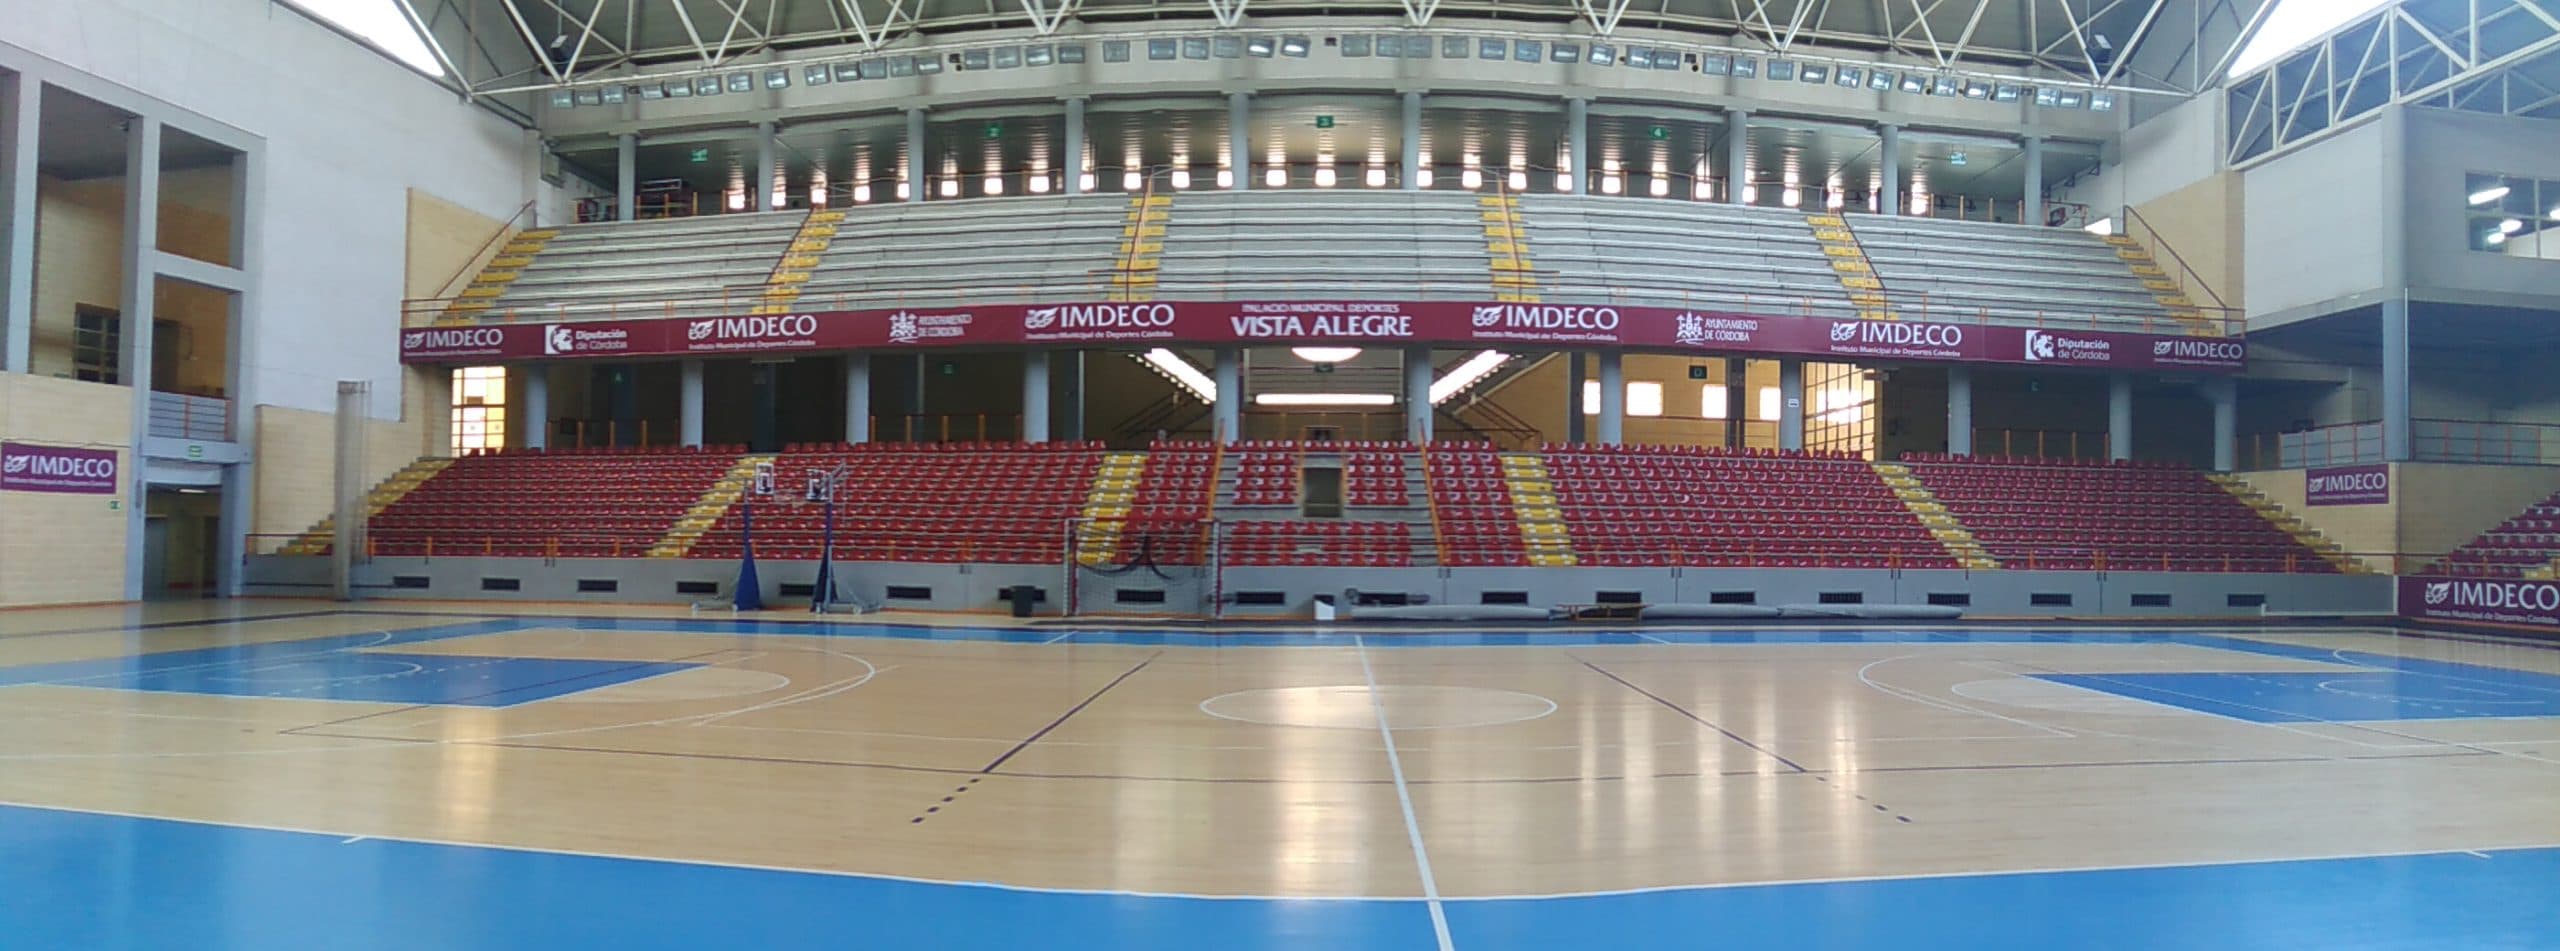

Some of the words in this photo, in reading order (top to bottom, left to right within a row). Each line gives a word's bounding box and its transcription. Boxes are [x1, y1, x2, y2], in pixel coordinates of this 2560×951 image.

[1060, 304, 1175, 328] IMDECO
[1347, 304, 1400, 313] DEPORTES
[1506, 305, 1619, 330] IMDECO
[717, 314, 817, 338] IMDECO
[1230, 315, 1305, 337] VISTA
[1311, 315, 1414, 337] ALEGRE
[1704, 318, 1759, 331] AYUNTAMIENTO
[1704, 329, 1714, 340] DE
[1861, 322, 1962, 346] IMDECO
[425, 328, 504, 348] IMDECO
[2058, 338, 2110, 350] Diputación
[2058, 348, 2070, 359] de
[2072, 349, 2110, 360] Córdoba
[2174, 340, 2243, 359] IMDECO
[31, 454, 114, 477] IMDECO
[2325, 472, 2387, 492] IMDECO
[2453, 581, 2560, 611] IMDECO
